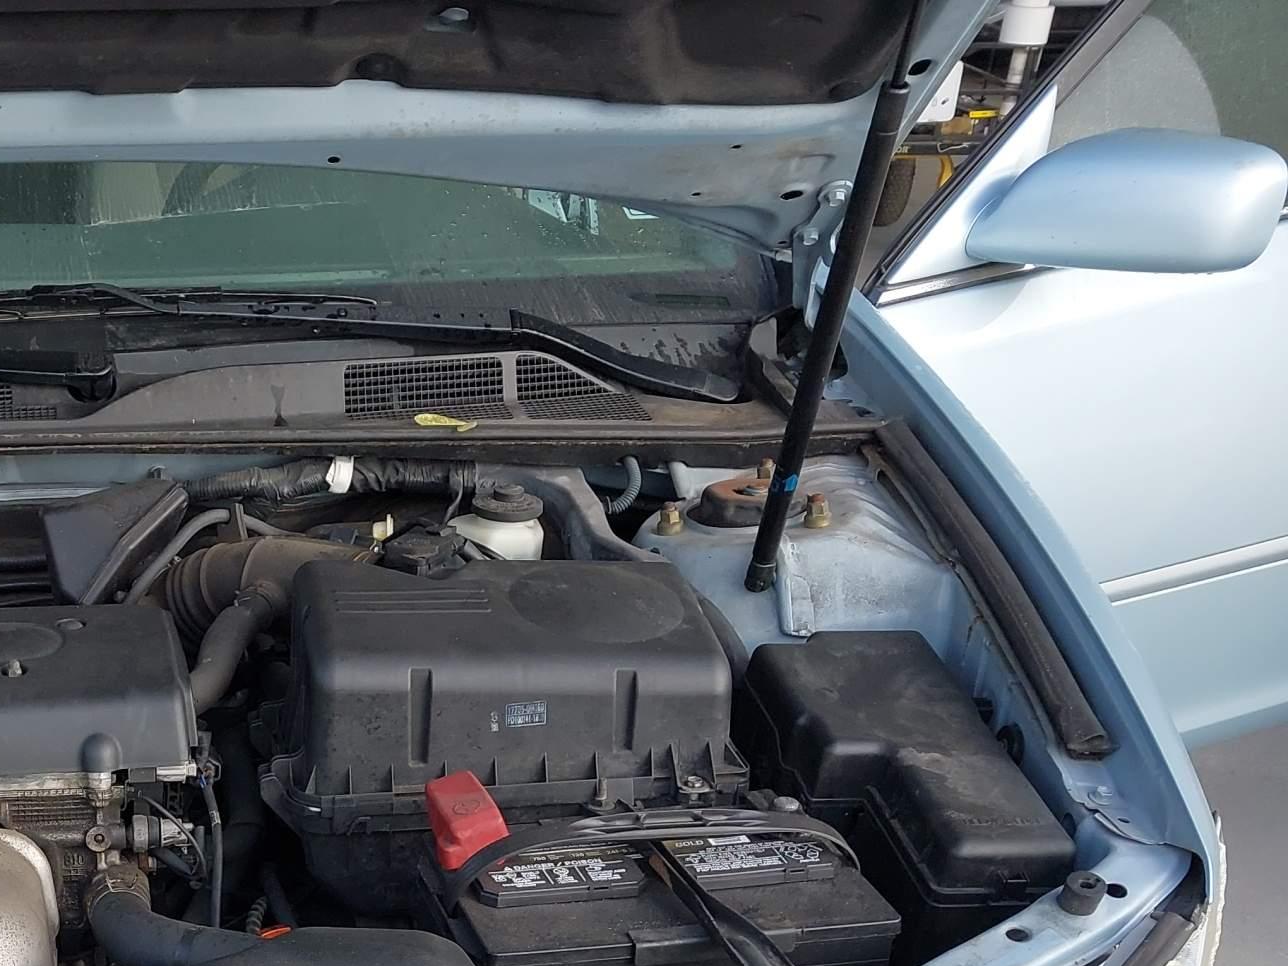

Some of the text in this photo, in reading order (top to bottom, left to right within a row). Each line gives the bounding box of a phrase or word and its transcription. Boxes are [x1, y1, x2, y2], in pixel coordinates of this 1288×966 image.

[674, 839, 705, 848] GOLD
[513, 862, 555, 871] DANGER
[564, 857, 603, 867] POISON
